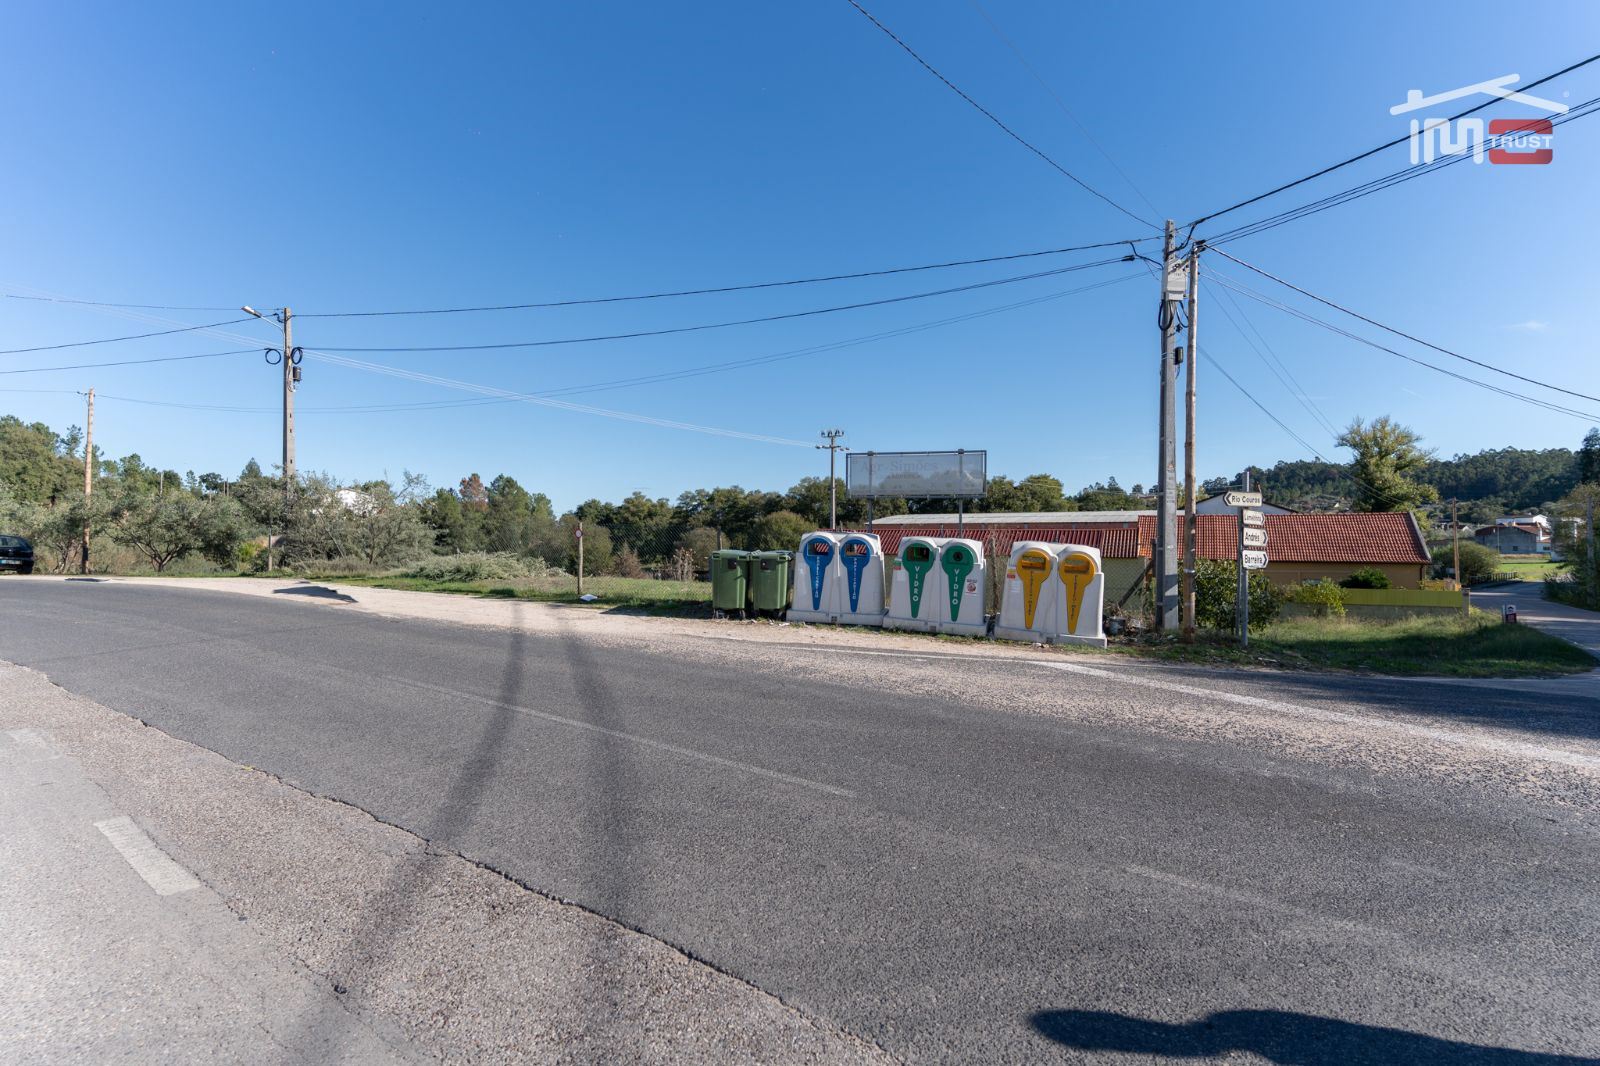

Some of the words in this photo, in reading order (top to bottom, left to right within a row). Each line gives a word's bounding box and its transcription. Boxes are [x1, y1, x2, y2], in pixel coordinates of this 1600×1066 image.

[1231, 495, 1240, 503] Rio
[1244, 554, 1263, 564] Barreira
[912, 566, 920, 602] VIDRO
[952, 569, 960, 605] VIDRO
